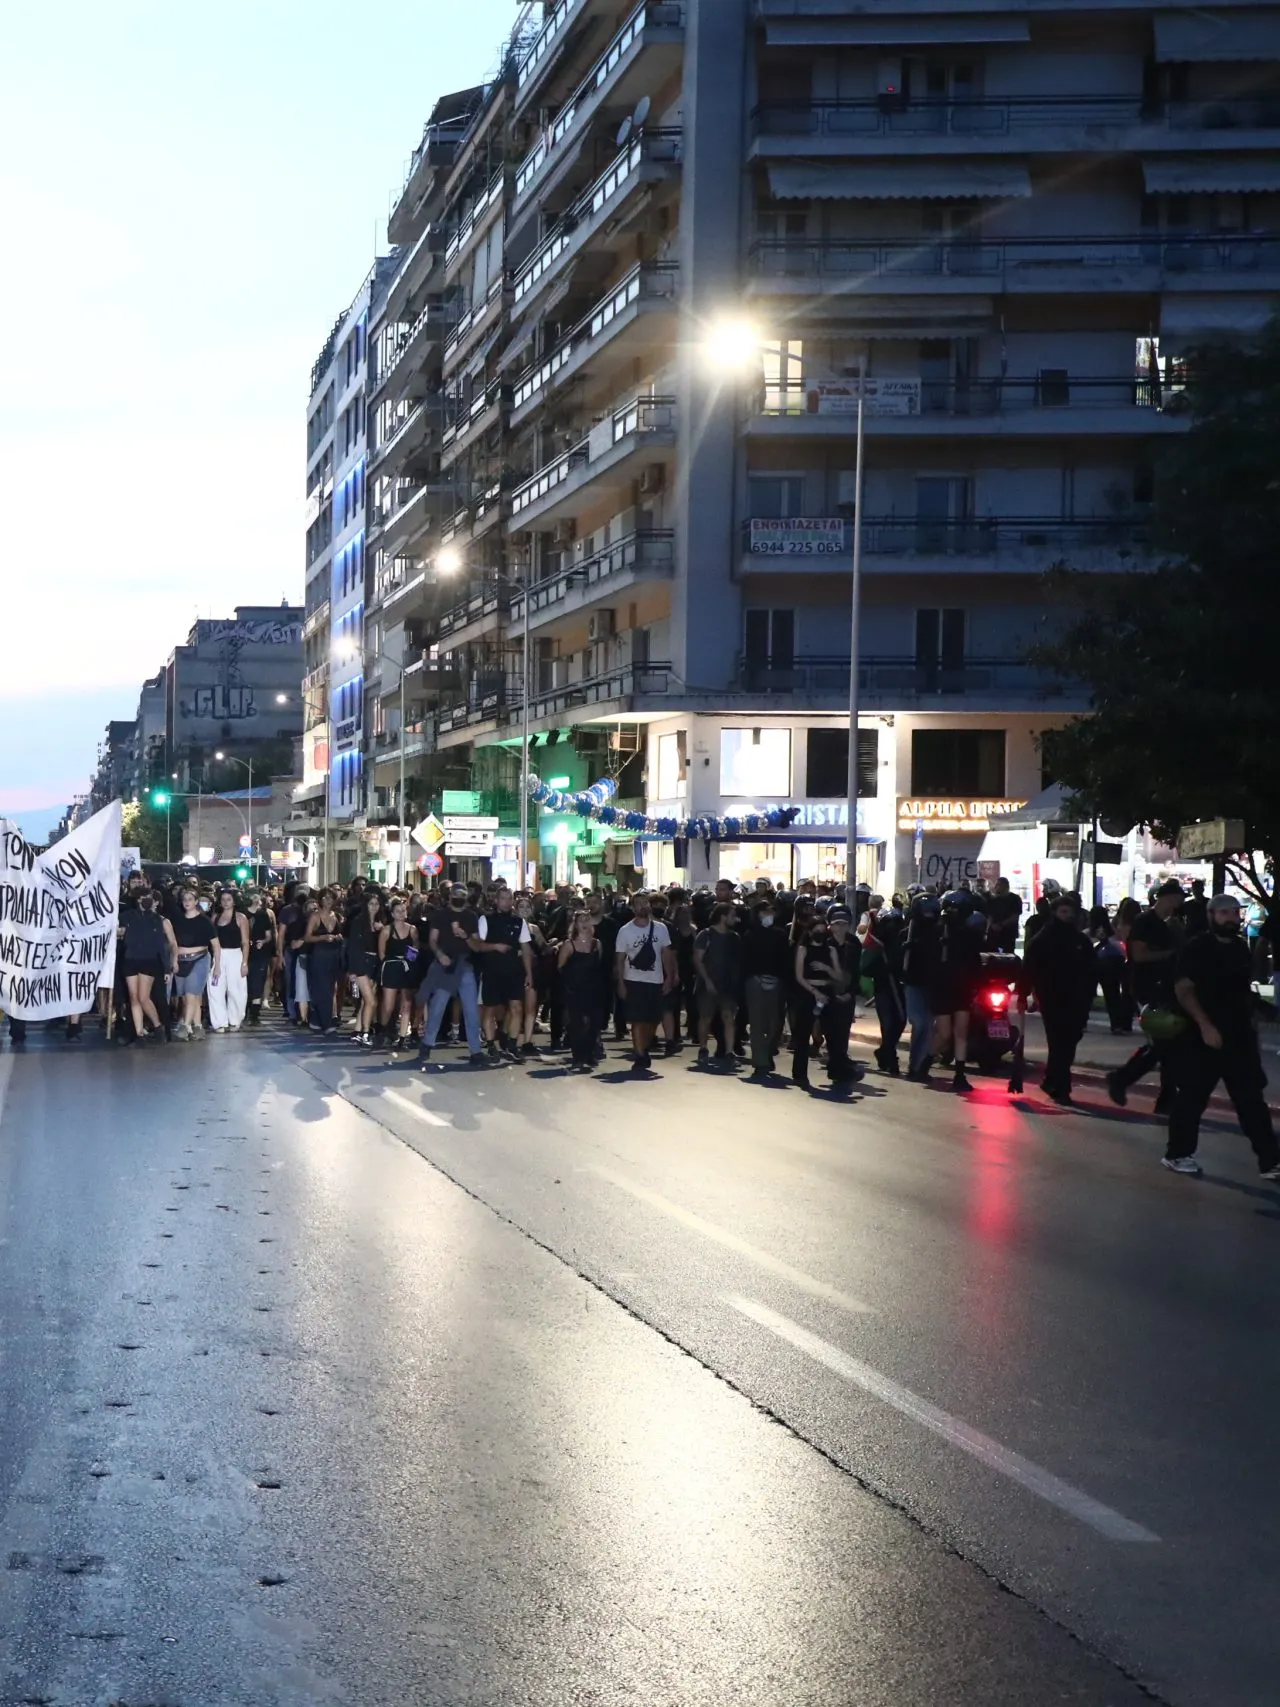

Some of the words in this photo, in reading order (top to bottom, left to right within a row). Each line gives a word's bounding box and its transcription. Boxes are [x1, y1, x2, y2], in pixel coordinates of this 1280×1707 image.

[752, 542, 784, 553] 6944
[789, 542, 813, 553] 225
[817, 542, 842, 553] 065
[900, 801, 967, 818] ALPHA
[9, 972, 61, 1008] ΛΟΥΚΜΑΝ
